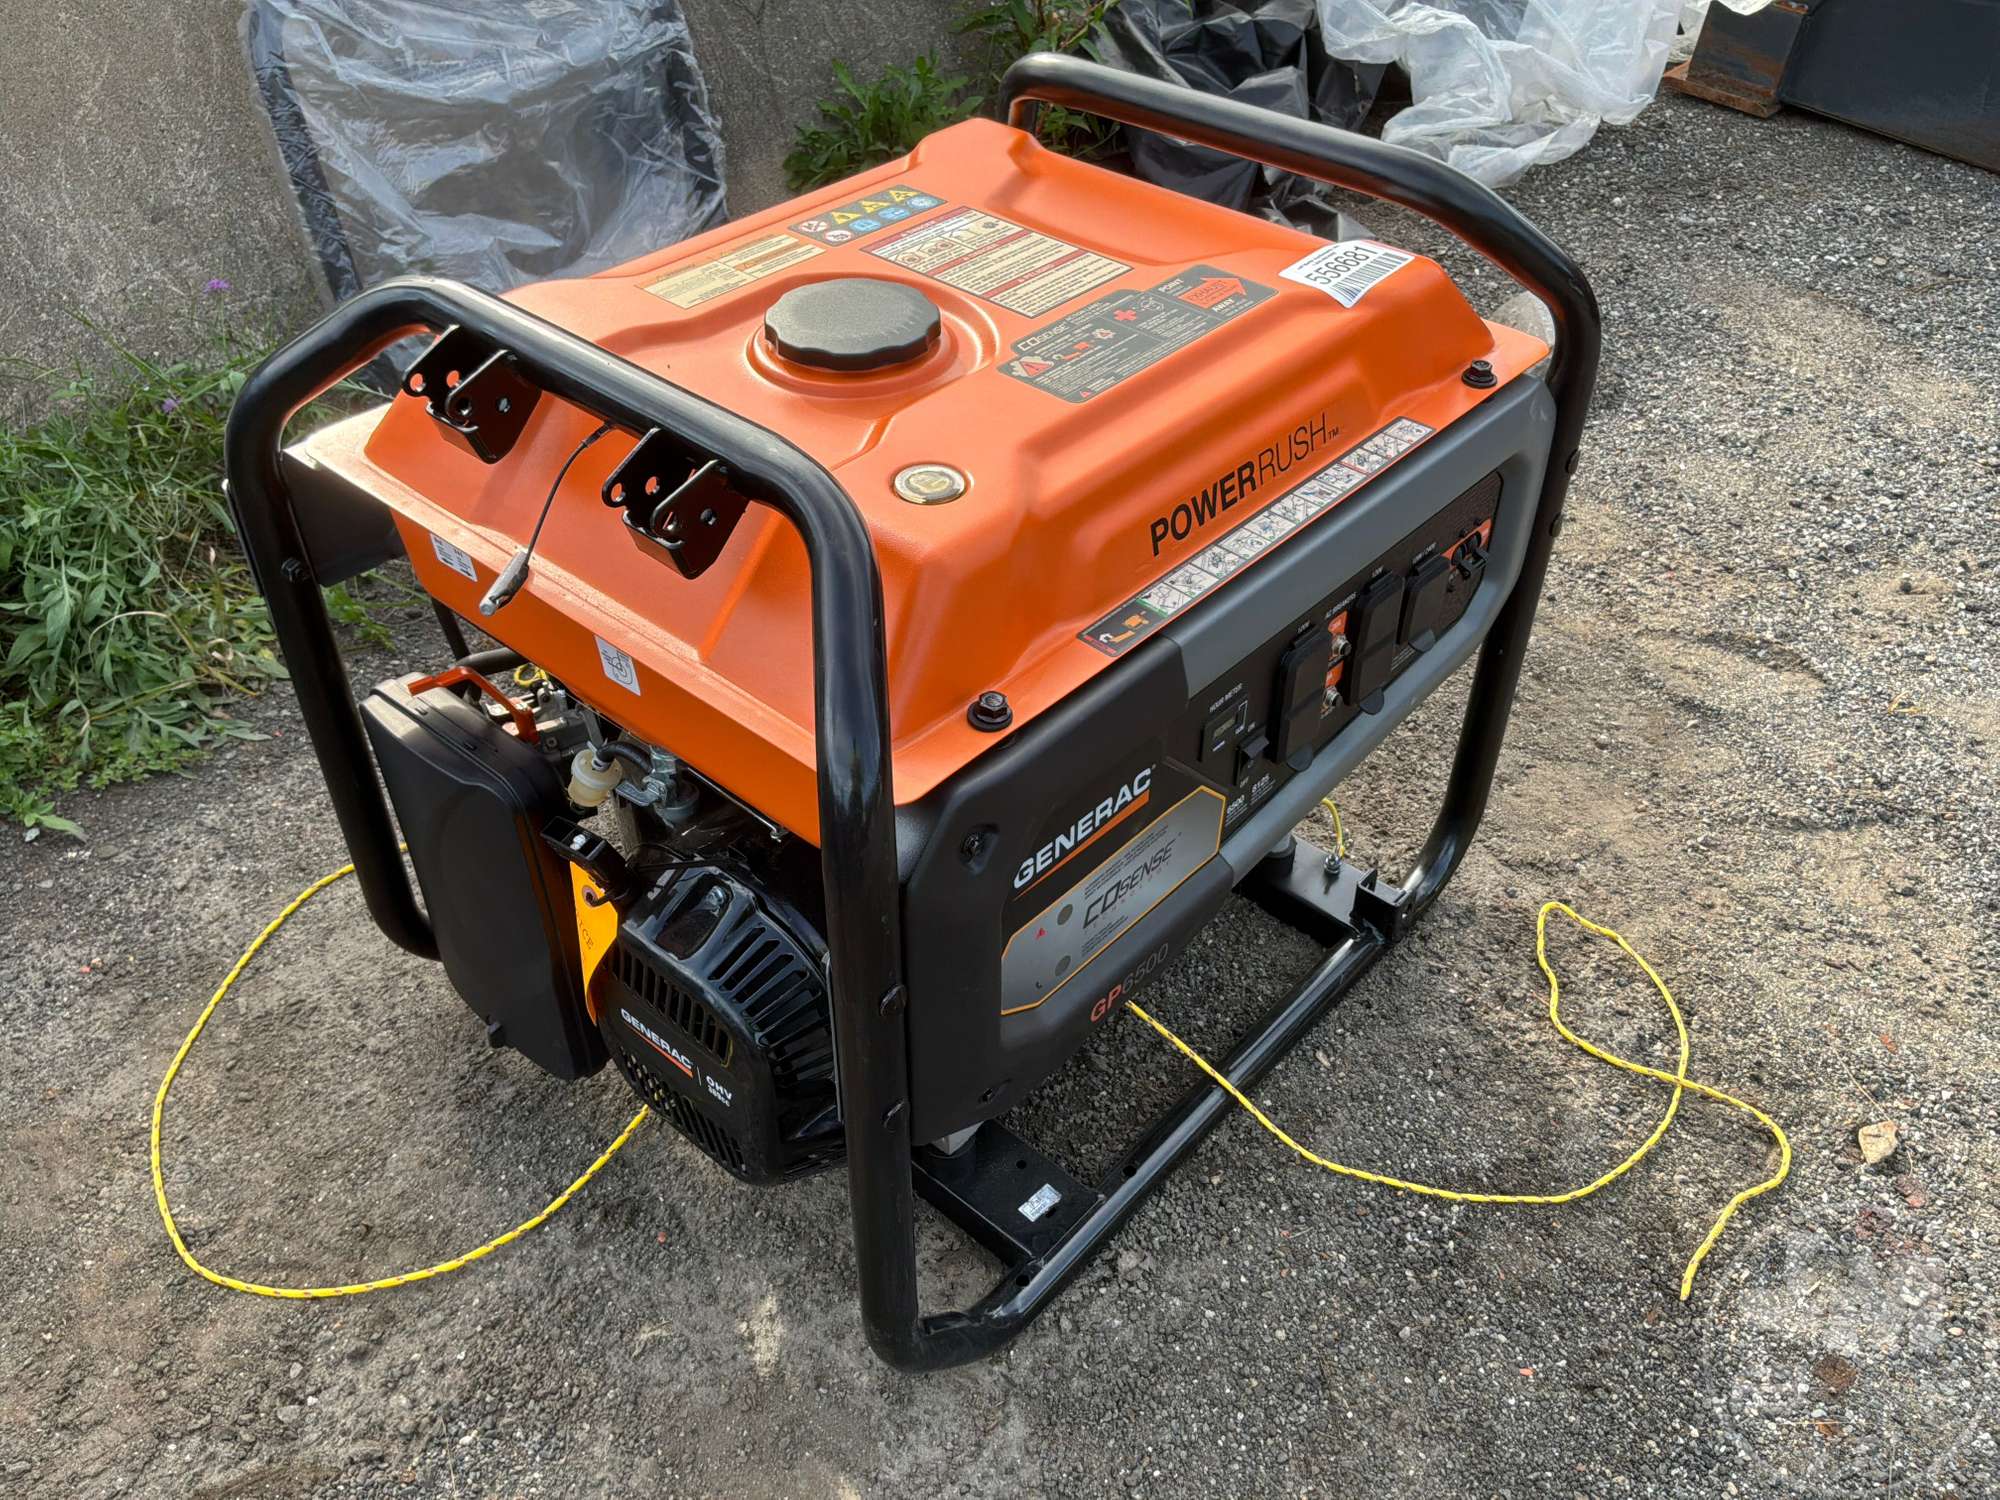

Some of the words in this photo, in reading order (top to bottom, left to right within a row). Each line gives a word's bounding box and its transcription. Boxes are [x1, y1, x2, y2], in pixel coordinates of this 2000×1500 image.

[1305, 246, 1378, 285] 556681
[1013, 767, 1152, 889] GENERAC
[1090, 943, 1169, 1023] GP6500
[620, 1008, 694, 1070] GENERAC
[706, 1075, 732, 1101] OHV
